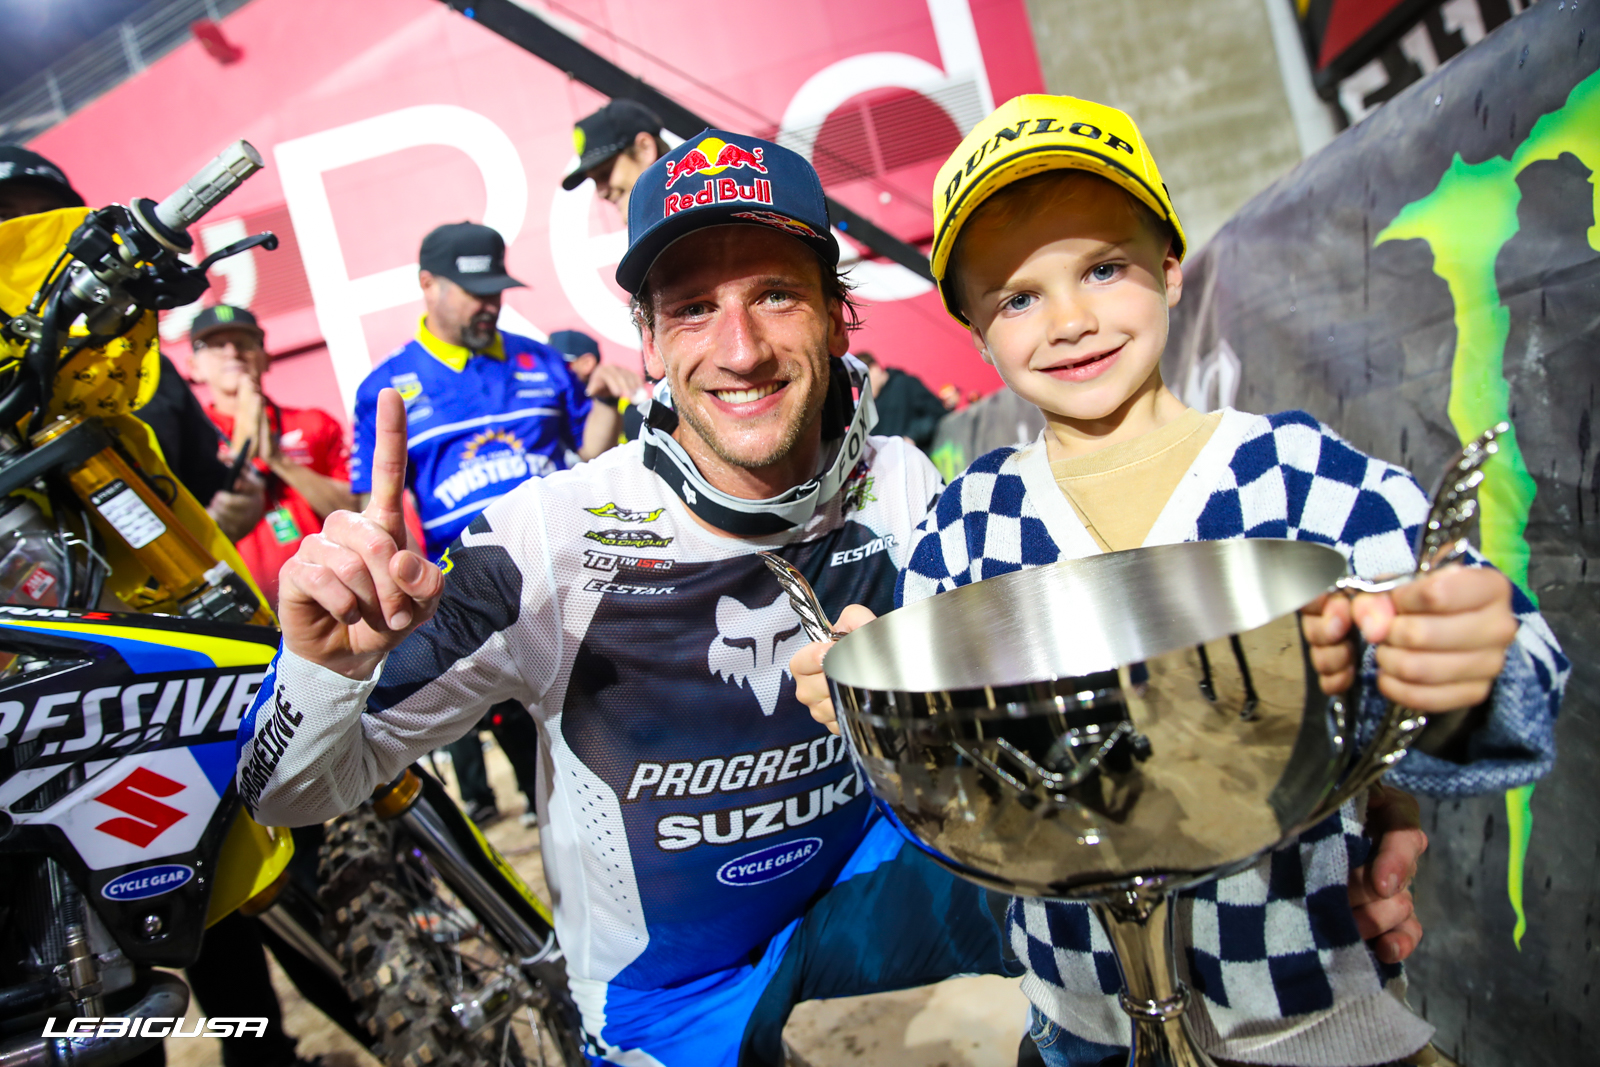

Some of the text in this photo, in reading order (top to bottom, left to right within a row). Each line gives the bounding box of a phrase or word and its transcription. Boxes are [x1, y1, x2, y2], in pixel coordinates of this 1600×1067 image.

[944, 118, 1135, 214] DUNLOP
[664, 178, 773, 218] Red Bull
[837, 407, 868, 485] FOX
[433, 453, 528, 510] TWISTED
[830, 533, 899, 568] ECSTAR
[584, 579, 677, 596] ECSTAR
[626, 734, 847, 801] PROGRESSI
[657, 772, 865, 851] SUZUKI
[109, 870, 185, 895] CYCLE GEAR
[726, 844, 813, 880] CYCLE GEAR
